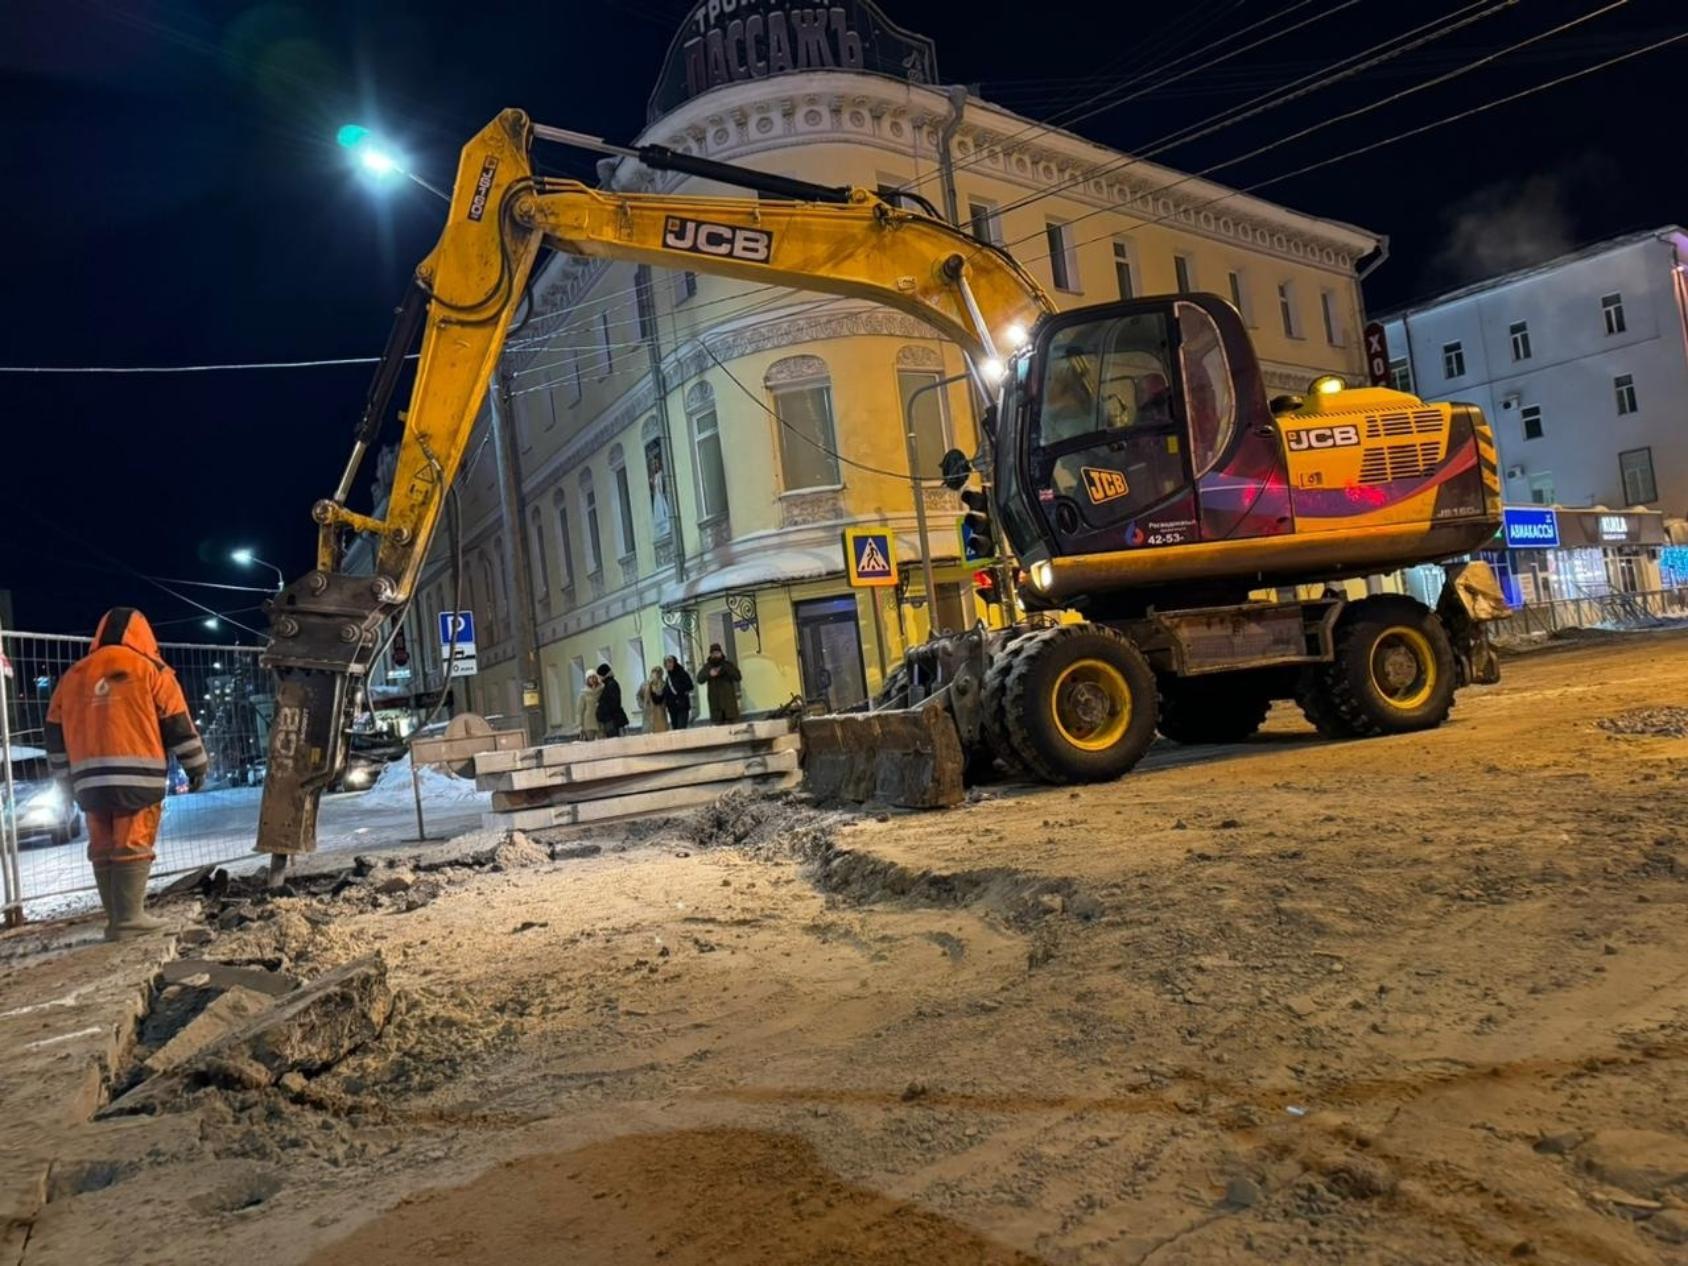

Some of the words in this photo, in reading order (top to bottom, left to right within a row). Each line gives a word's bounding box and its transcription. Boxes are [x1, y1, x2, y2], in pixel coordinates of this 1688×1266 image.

[684, 7, 864, 98] ПАССАЖЪ
[665, 218, 769, 260] JCB
[1287, 425, 1359, 450] JCB
[1089, 470, 1125, 501] JCB
[447, 616, 466, 640] P
